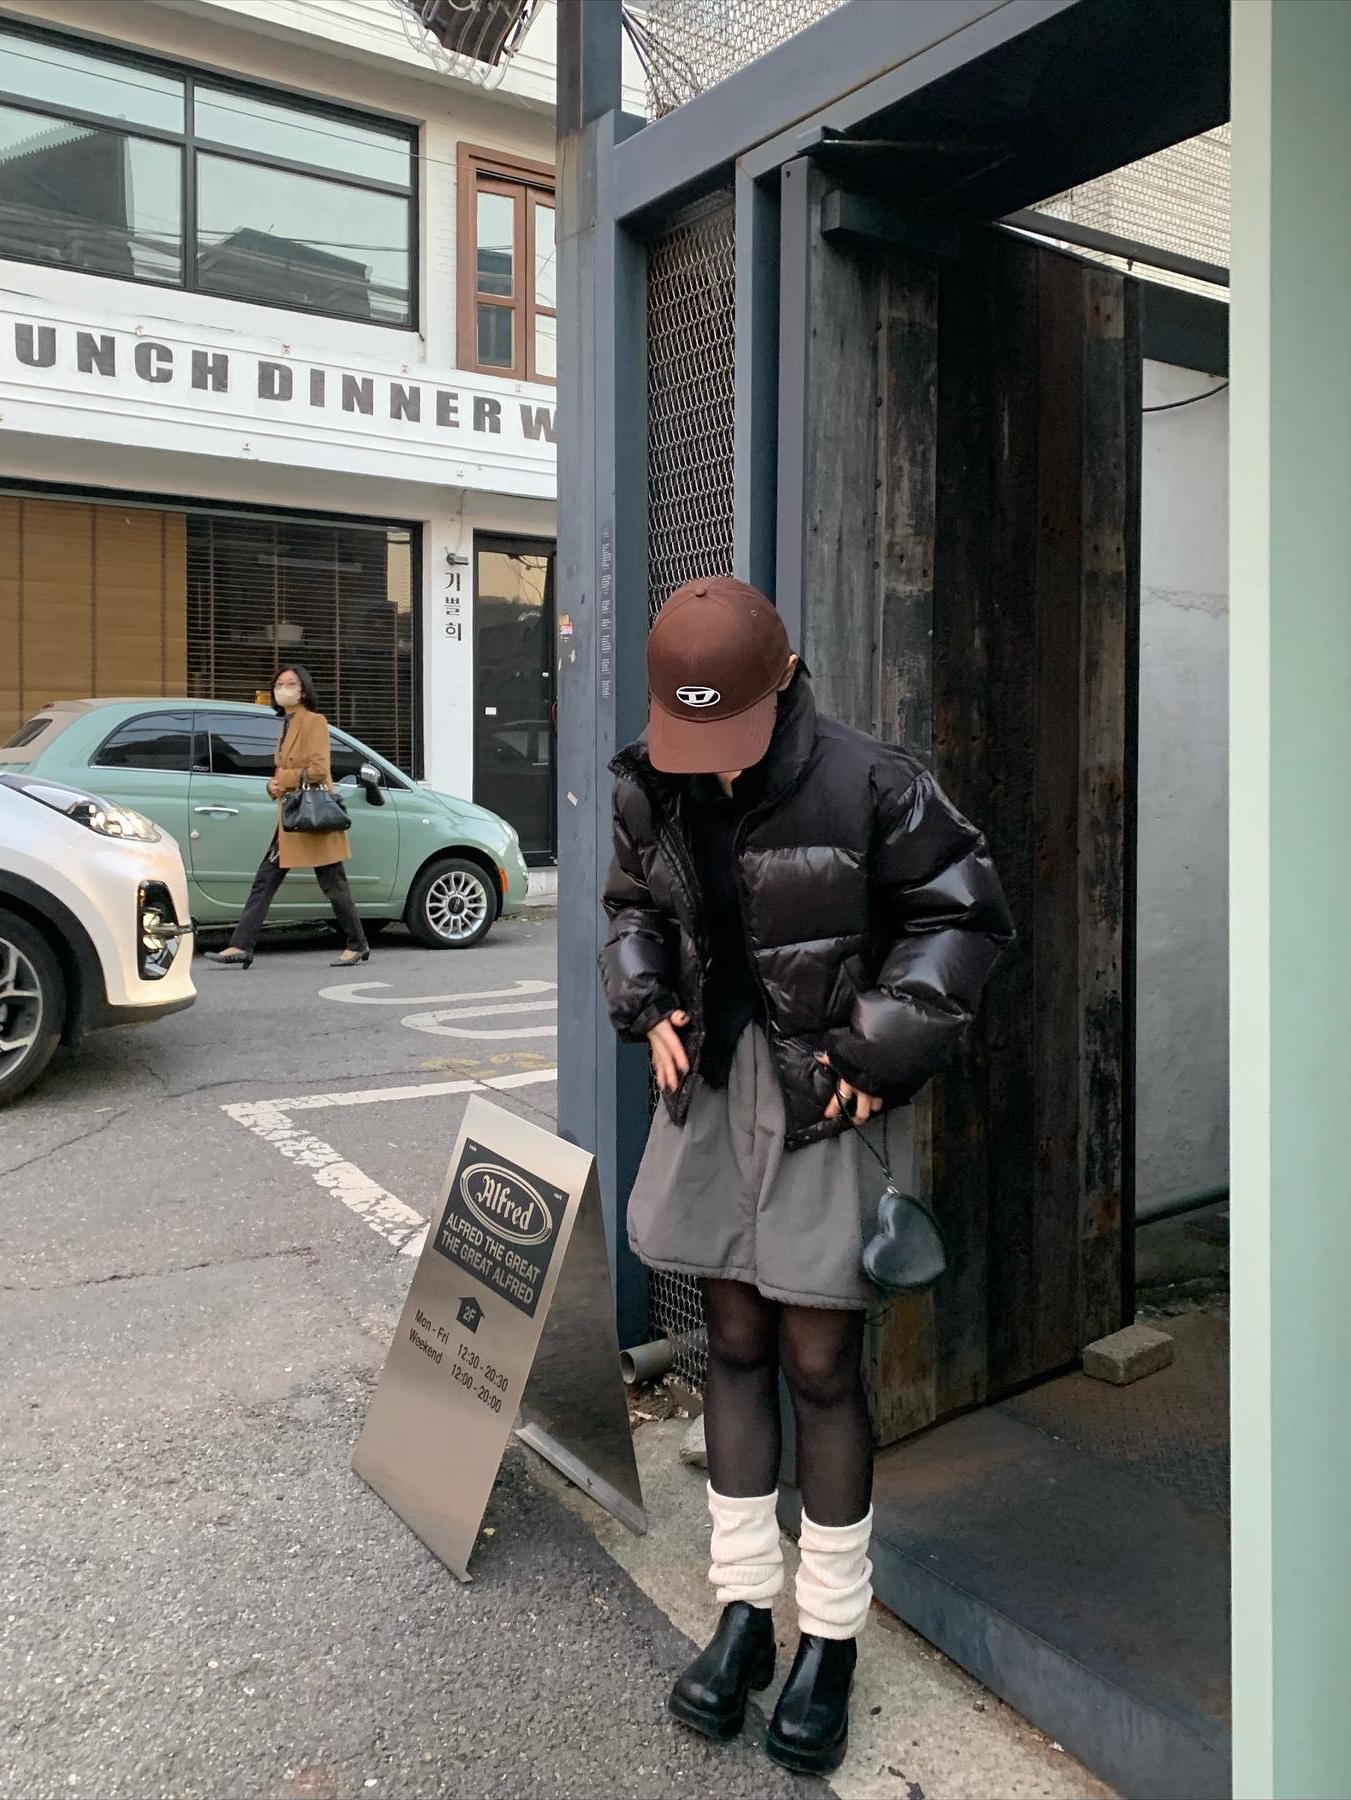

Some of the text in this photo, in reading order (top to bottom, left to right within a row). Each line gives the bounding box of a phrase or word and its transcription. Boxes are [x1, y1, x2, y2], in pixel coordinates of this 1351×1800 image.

[15, 322, 229, 393] UNCH
[258, 360, 502, 434] DINNER
[475, 1174, 534, 1231] Alfred
[442, 1230, 534, 1304] THE GREAT ALFRED
[445, 1212, 541, 1283] ALFRED THE GREAT
[415, 1308, 432, 1332] Mon
[436, 1327, 450, 1344] Fri
[458, 1343, 480, 1369] 12:30
[484, 1365, 509, 1392] 20:30
[462, 1305, 477, 1323] 2F
[409, 1327, 444, 1364] Weekend
[451, 1363, 474, 1390] 12:00
[477, 1385, 502, 1413] 20:00
